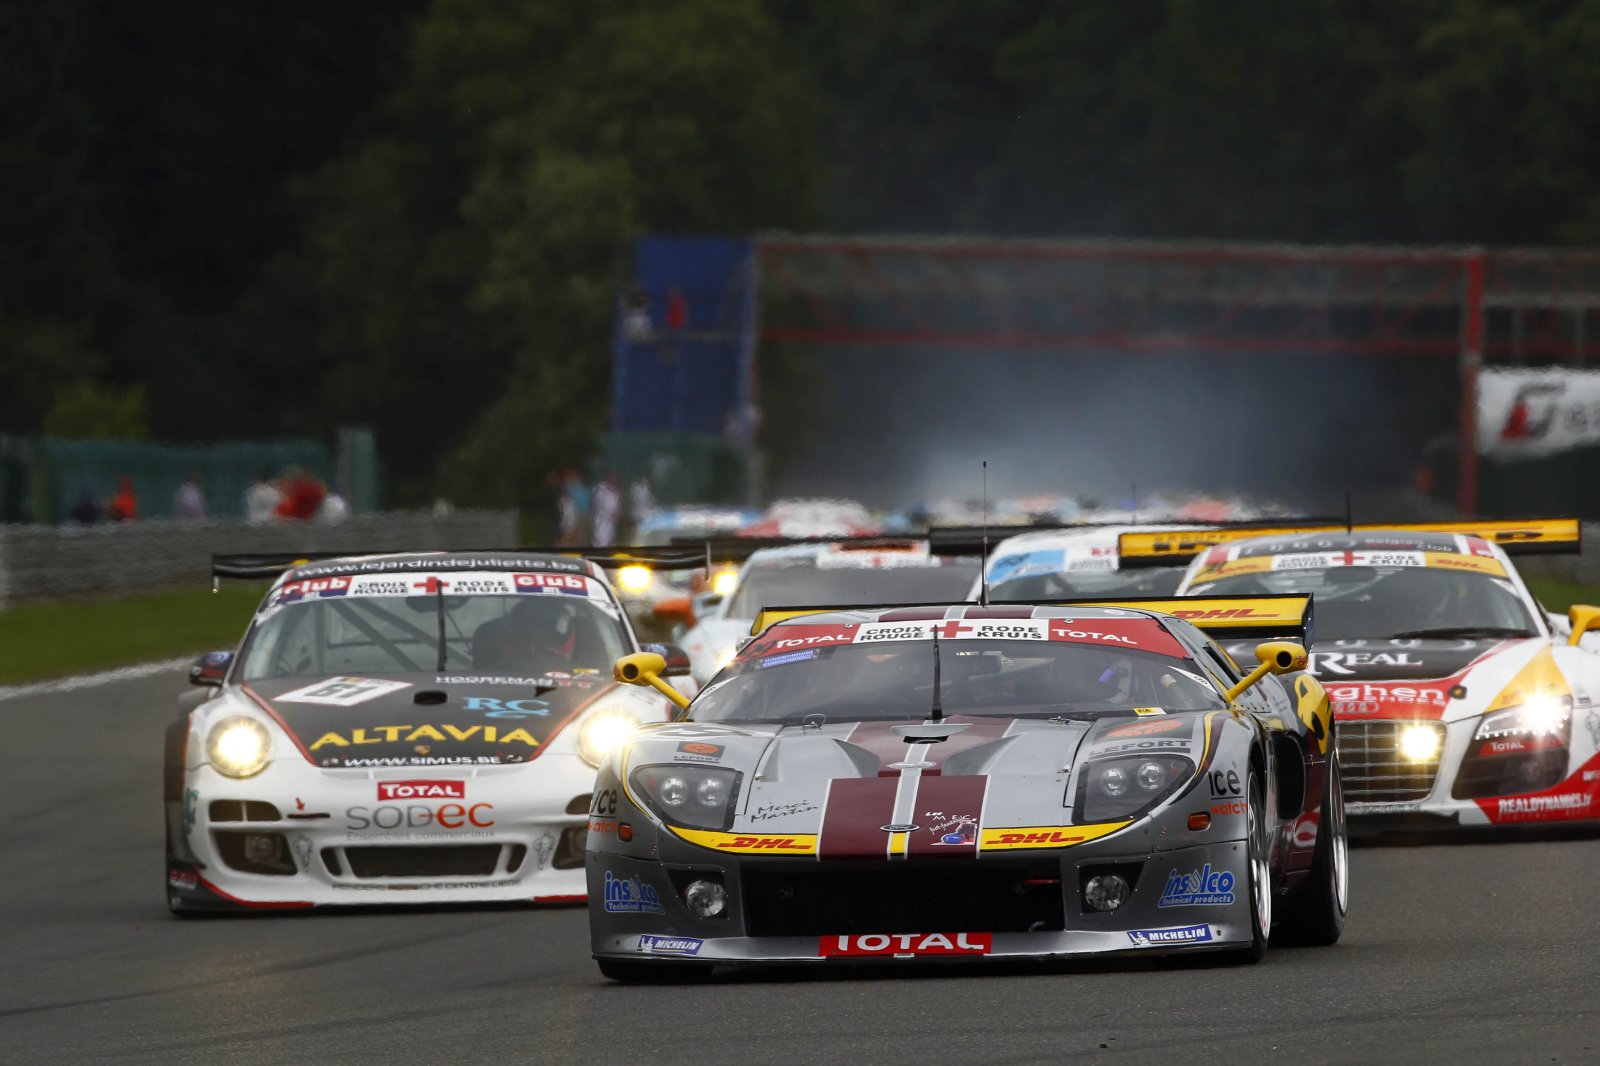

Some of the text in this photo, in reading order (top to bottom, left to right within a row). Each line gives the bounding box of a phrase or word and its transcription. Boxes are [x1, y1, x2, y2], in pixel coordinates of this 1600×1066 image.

[457, 580, 506, 588] RODE
[1171, 609, 1270, 619] DHL
[865, 626, 922, 635] CROIX
[981, 625, 1039, 634] RODE
[776, 634, 851, 648] TOTAL
[977, 632, 1042, 640] KRUIS
[1052, 628, 1138, 645] TOTAL
[1304, 652, 1423, 675] REAL
[1325, 684, 1445, 704] ghen
[310, 724, 540, 750] ALTAVIA
[1090, 740, 1192, 756] LEFORT
[1490, 742, 1524, 752] TOTAL
[344, 756, 502, 767] WWW.SIMUS.BE
[381, 784, 461, 797] TOTAL
[727, 837, 805, 849] DHL
[993, 832, 1074, 844] DHL
[1194, 895, 1231, 904] products
[1149, 928, 1206, 940] MICHELIN
[655, 940, 699, 950] MICHELIN
